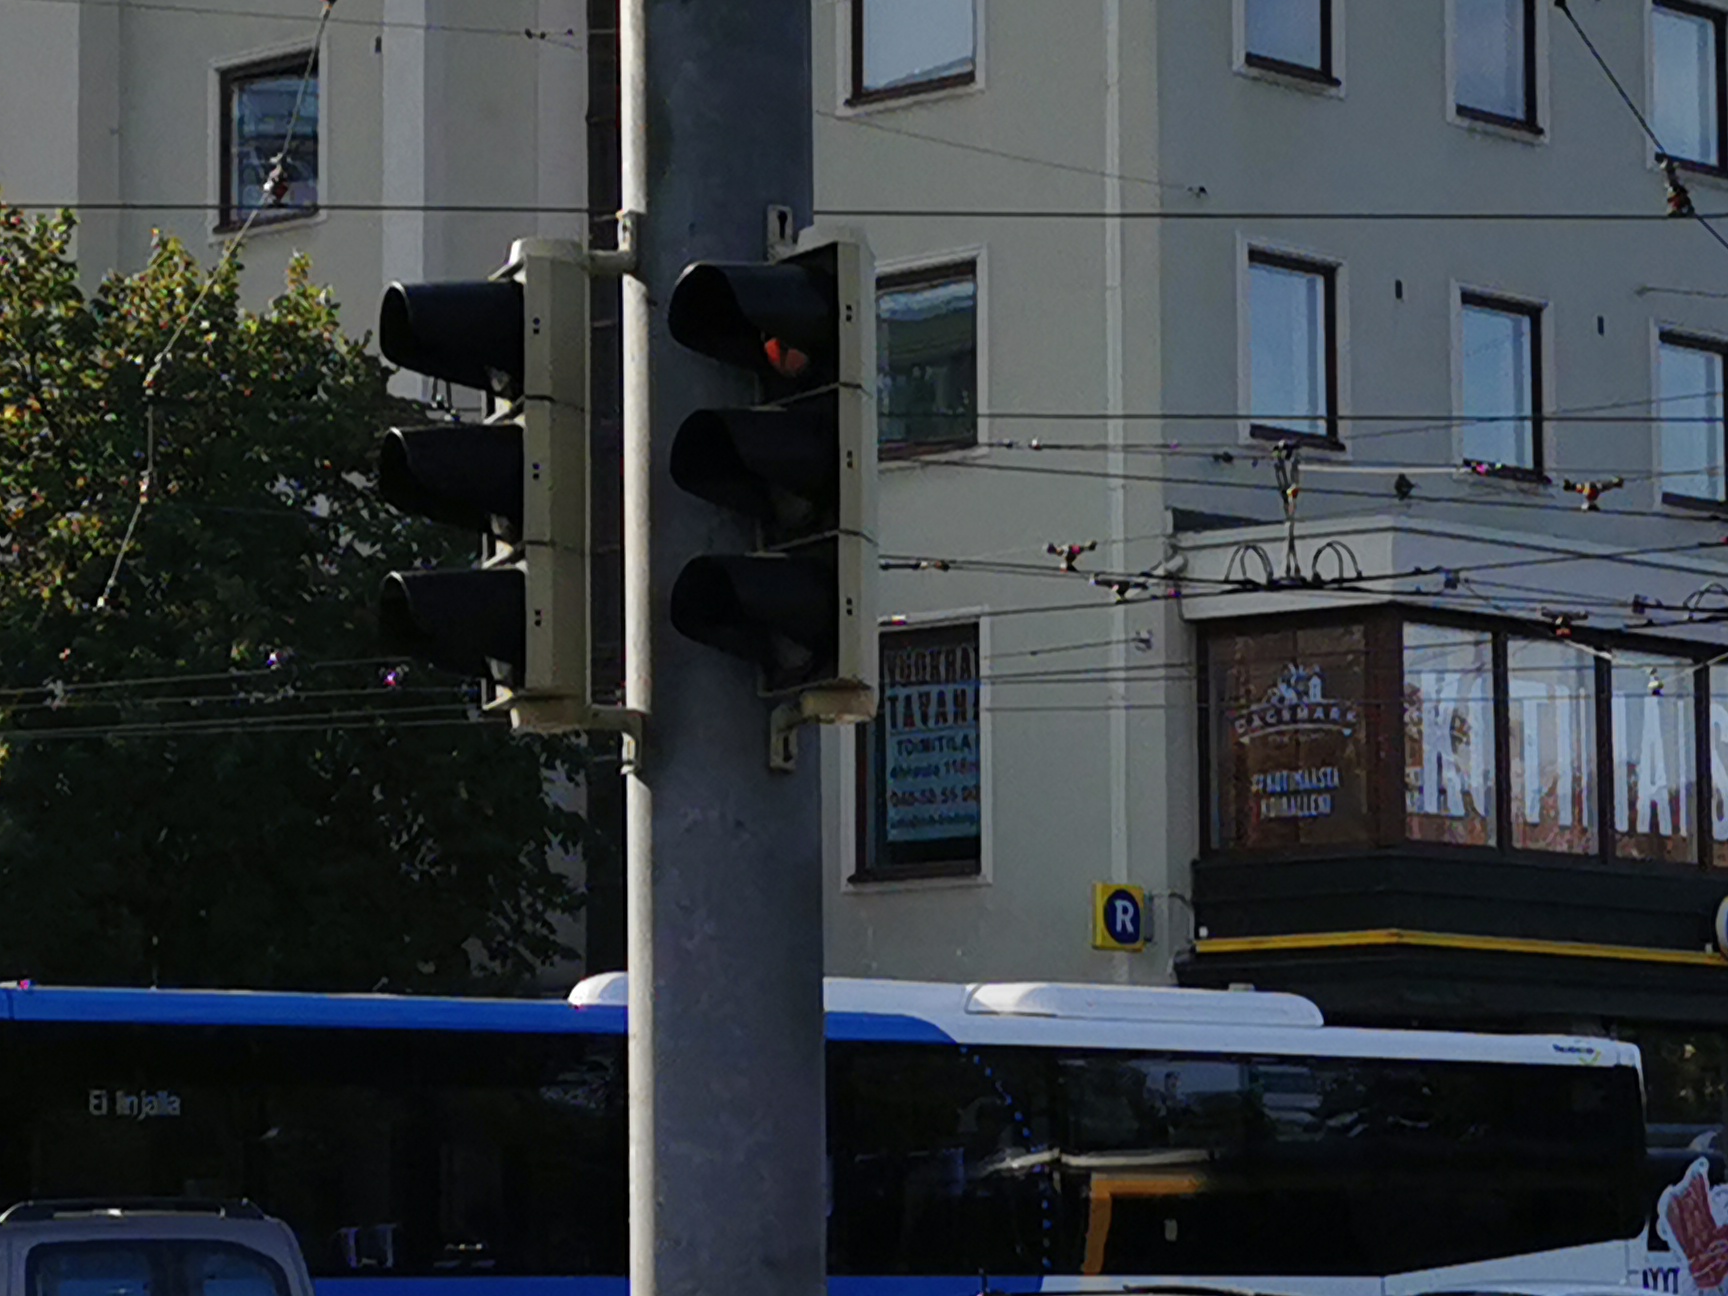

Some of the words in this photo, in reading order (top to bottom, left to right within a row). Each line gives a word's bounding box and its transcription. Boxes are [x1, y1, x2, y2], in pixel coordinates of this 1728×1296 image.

[887, 688, 978, 730] TAVAN
[1114, 899, 1135, 933] R
[88, 1089, 109, 1116] Ei
[116, 1089, 181, 1119] linjalla
